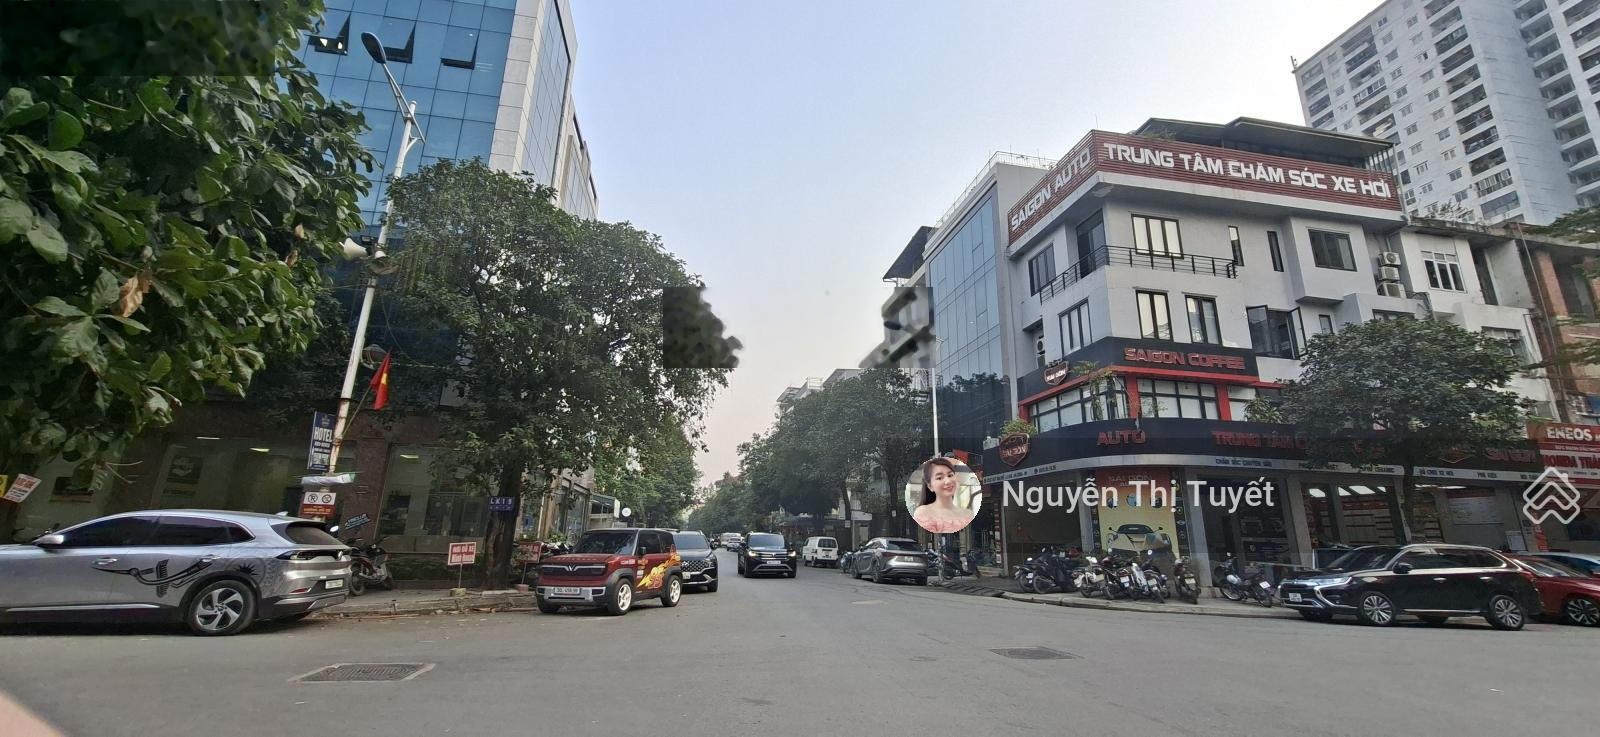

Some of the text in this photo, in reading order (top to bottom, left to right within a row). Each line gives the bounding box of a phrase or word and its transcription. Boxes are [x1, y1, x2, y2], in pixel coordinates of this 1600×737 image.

[1104, 142, 1391, 198] TRUNG TÂM CHĂM SÓC XE HƠI
[1011, 147, 1091, 231] SAIGON AUTO
[1124, 348, 1246, 370] SAIGON COFFEE
[314, 426, 333, 443] HOTEL
[1097, 431, 1146, 446] AUTO
[1546, 426, 1593, 442] ENEOS
